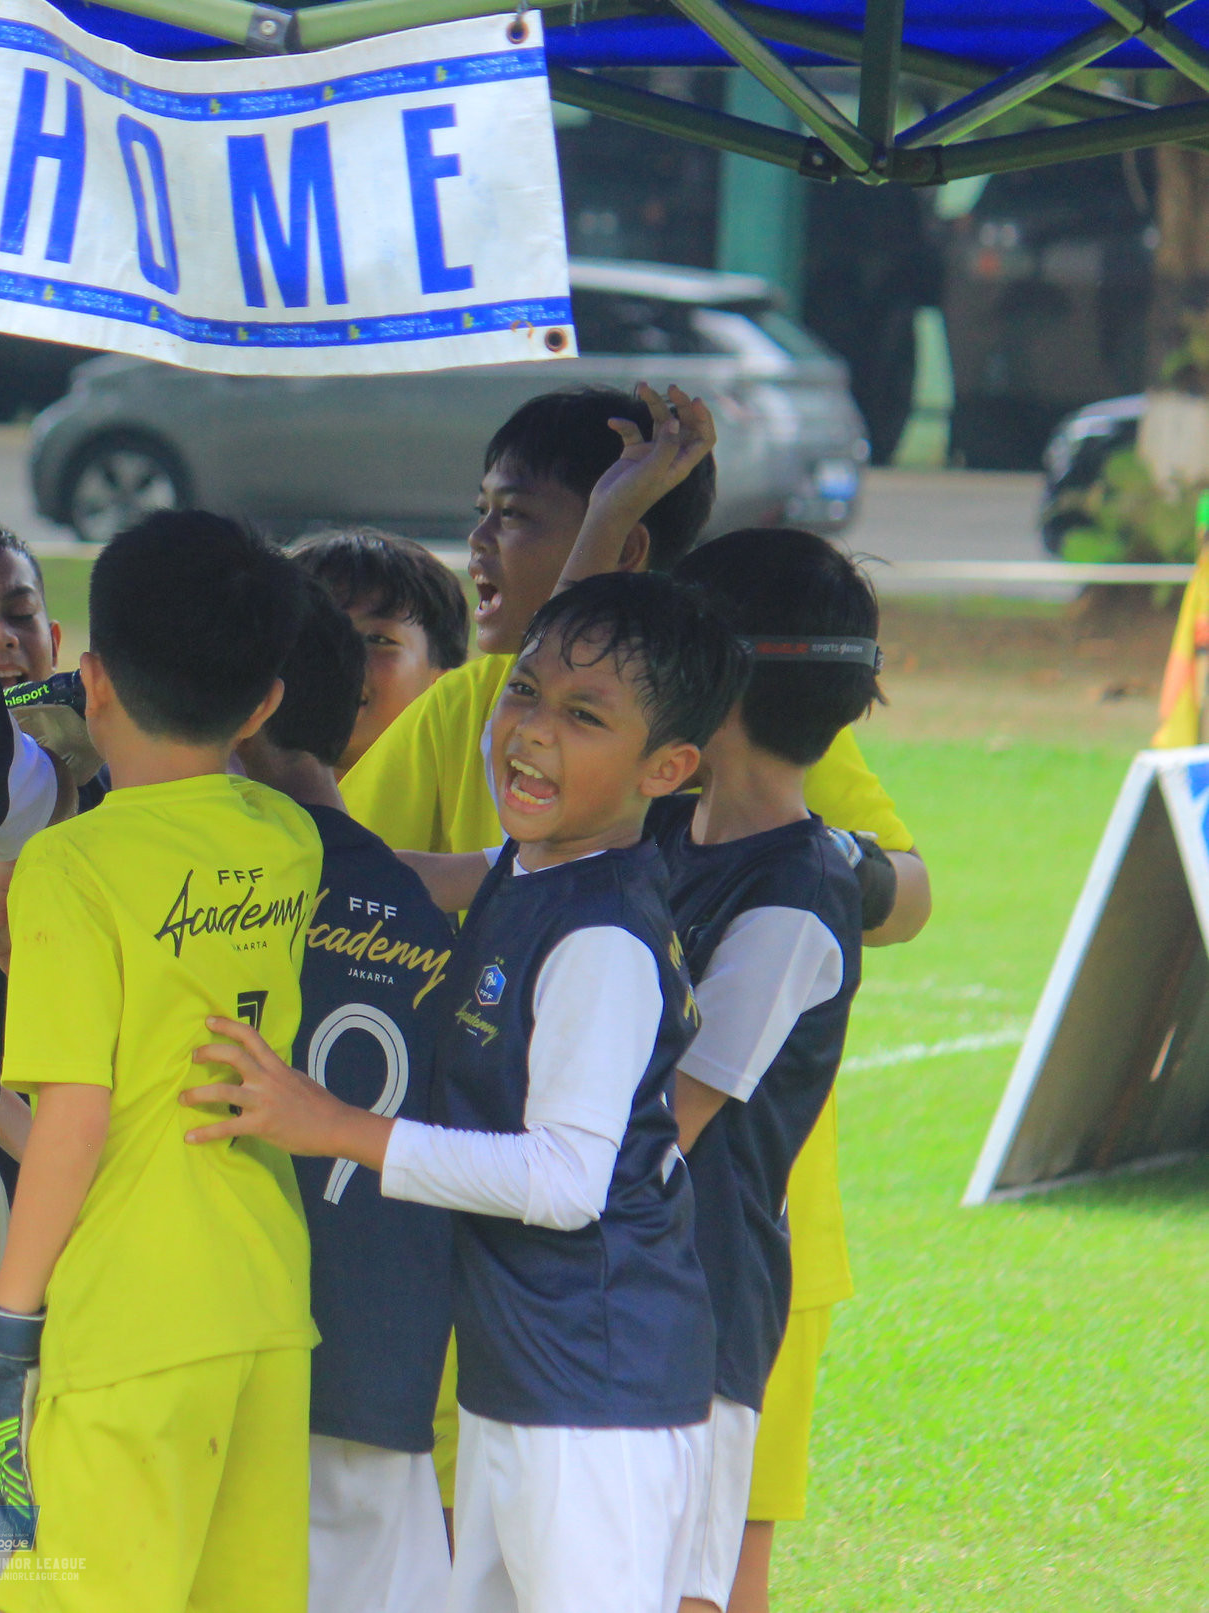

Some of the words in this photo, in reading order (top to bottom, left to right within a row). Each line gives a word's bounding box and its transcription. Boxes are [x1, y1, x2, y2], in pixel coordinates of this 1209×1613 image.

[5, 684, 50, 706] hlsport
[217, 867, 264, 885] FFF
[154, 869, 309, 963] Academy
[349, 896, 398, 919] FFF
[235, 940, 268, 952] KARTA
[348, 967, 395, 985] JAKARTA
[308, 1003, 409, 1205] 9
